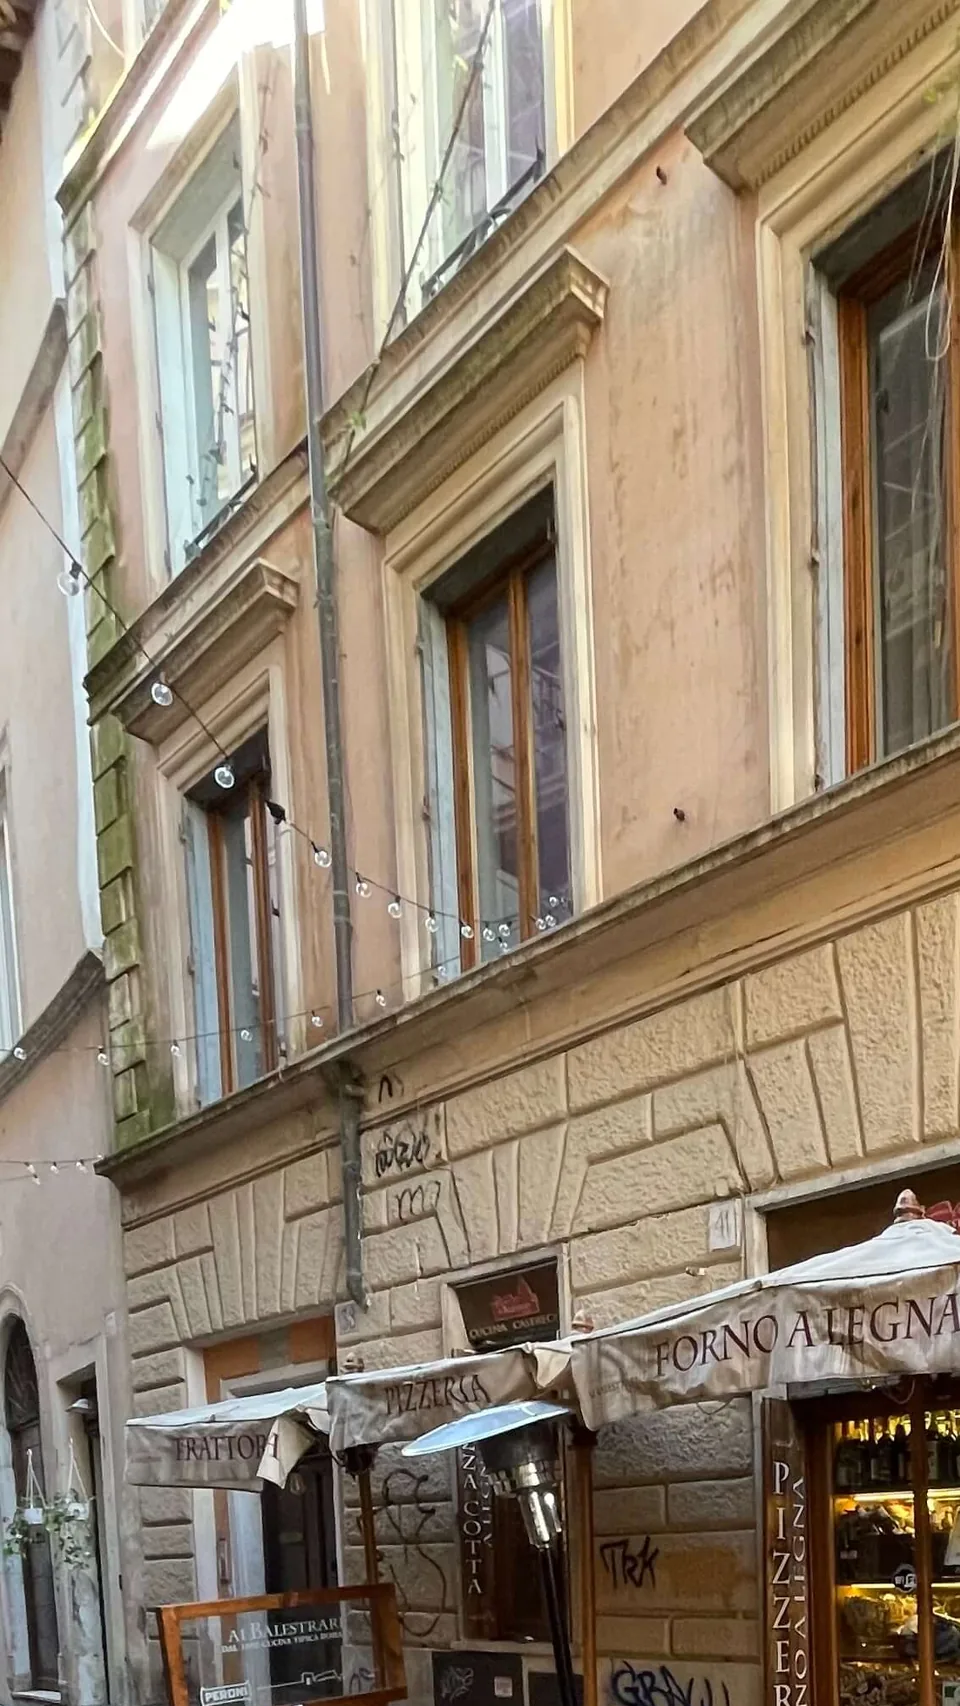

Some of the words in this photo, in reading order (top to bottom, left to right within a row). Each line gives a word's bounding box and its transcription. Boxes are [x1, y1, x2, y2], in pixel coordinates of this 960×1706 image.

[655, 1315, 779, 1377] FORNO
[786, 1310, 816, 1349] A
[383, 1373, 491, 1416] PIZZERIA
[463, 1500, 482, 1594] COTTA
[792, 1476, 807, 1602] LEGNA
[250, 1617, 341, 1640] BALESTRAR
[204, 1686, 249, 1702] PERONI
